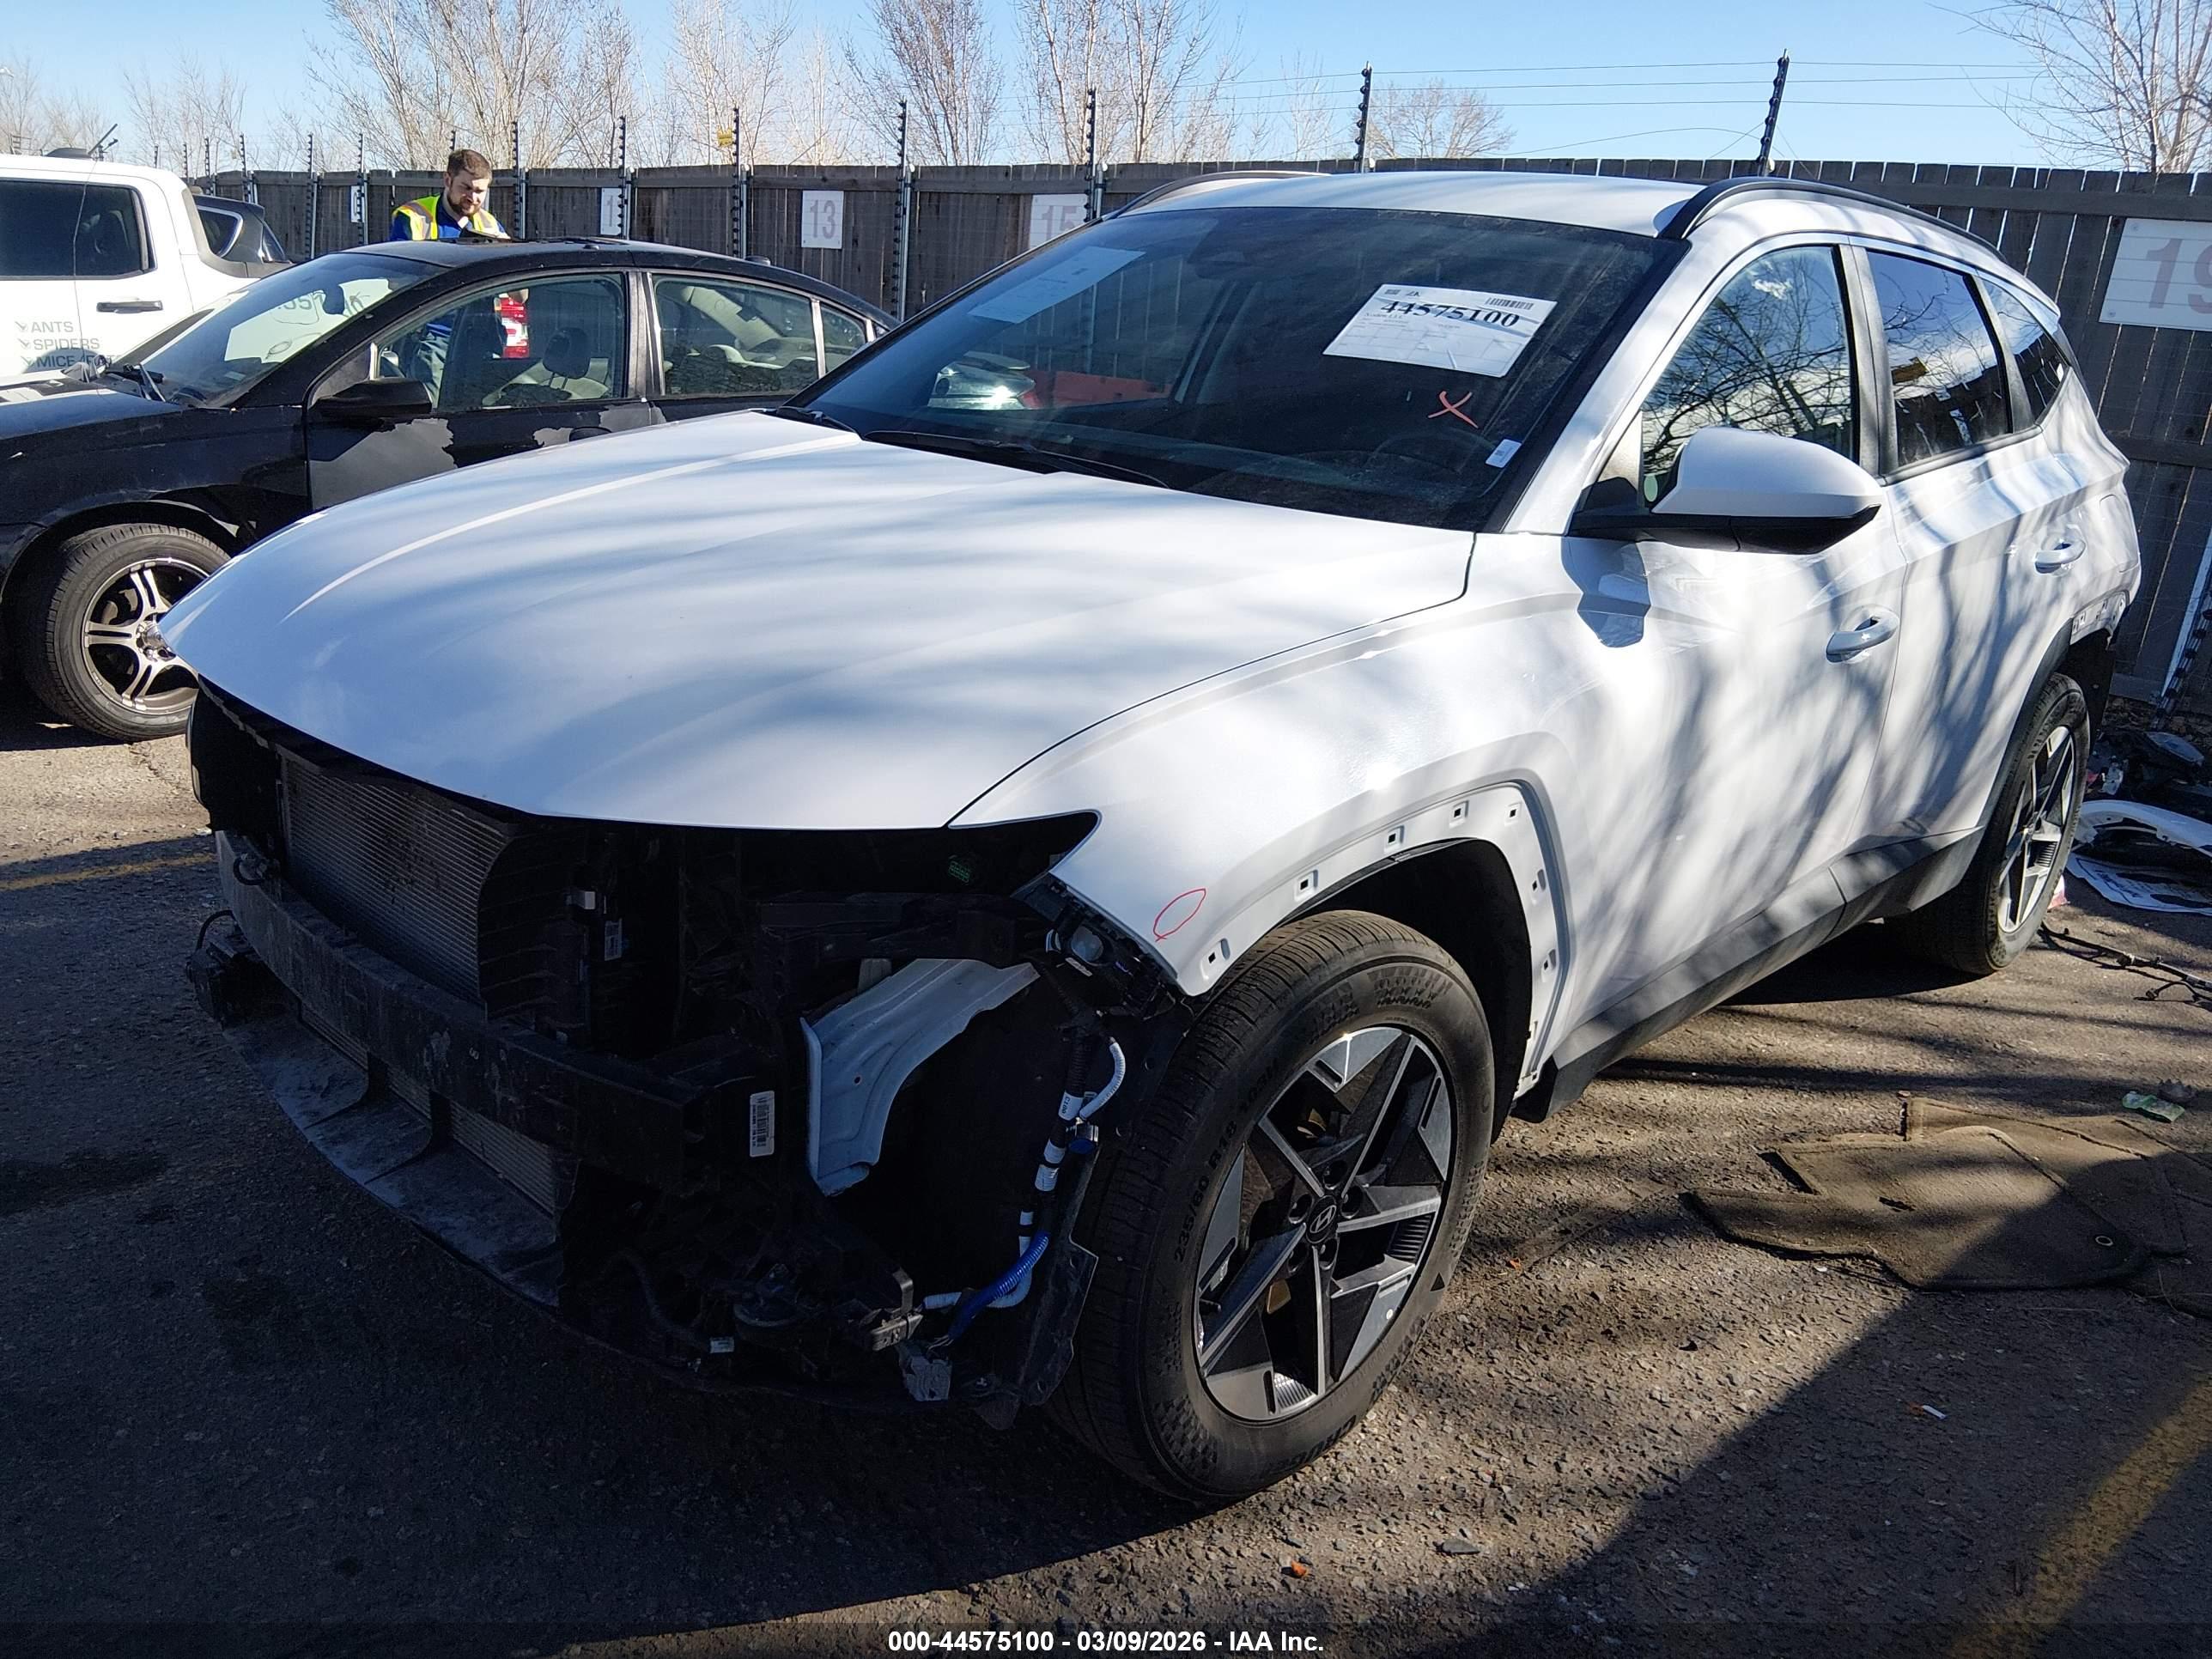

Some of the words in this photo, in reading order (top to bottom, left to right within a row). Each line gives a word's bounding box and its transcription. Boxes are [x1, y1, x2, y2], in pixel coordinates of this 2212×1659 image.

[810, 199, 836, 240] 13
[1041, 205, 1078, 240] 15
[1380, 301, 1520, 328] 44575100
[31, 321, 74, 333] ANTS
[33, 337, 100, 350] SPIDERS
[35, 355, 76, 368] MICE
